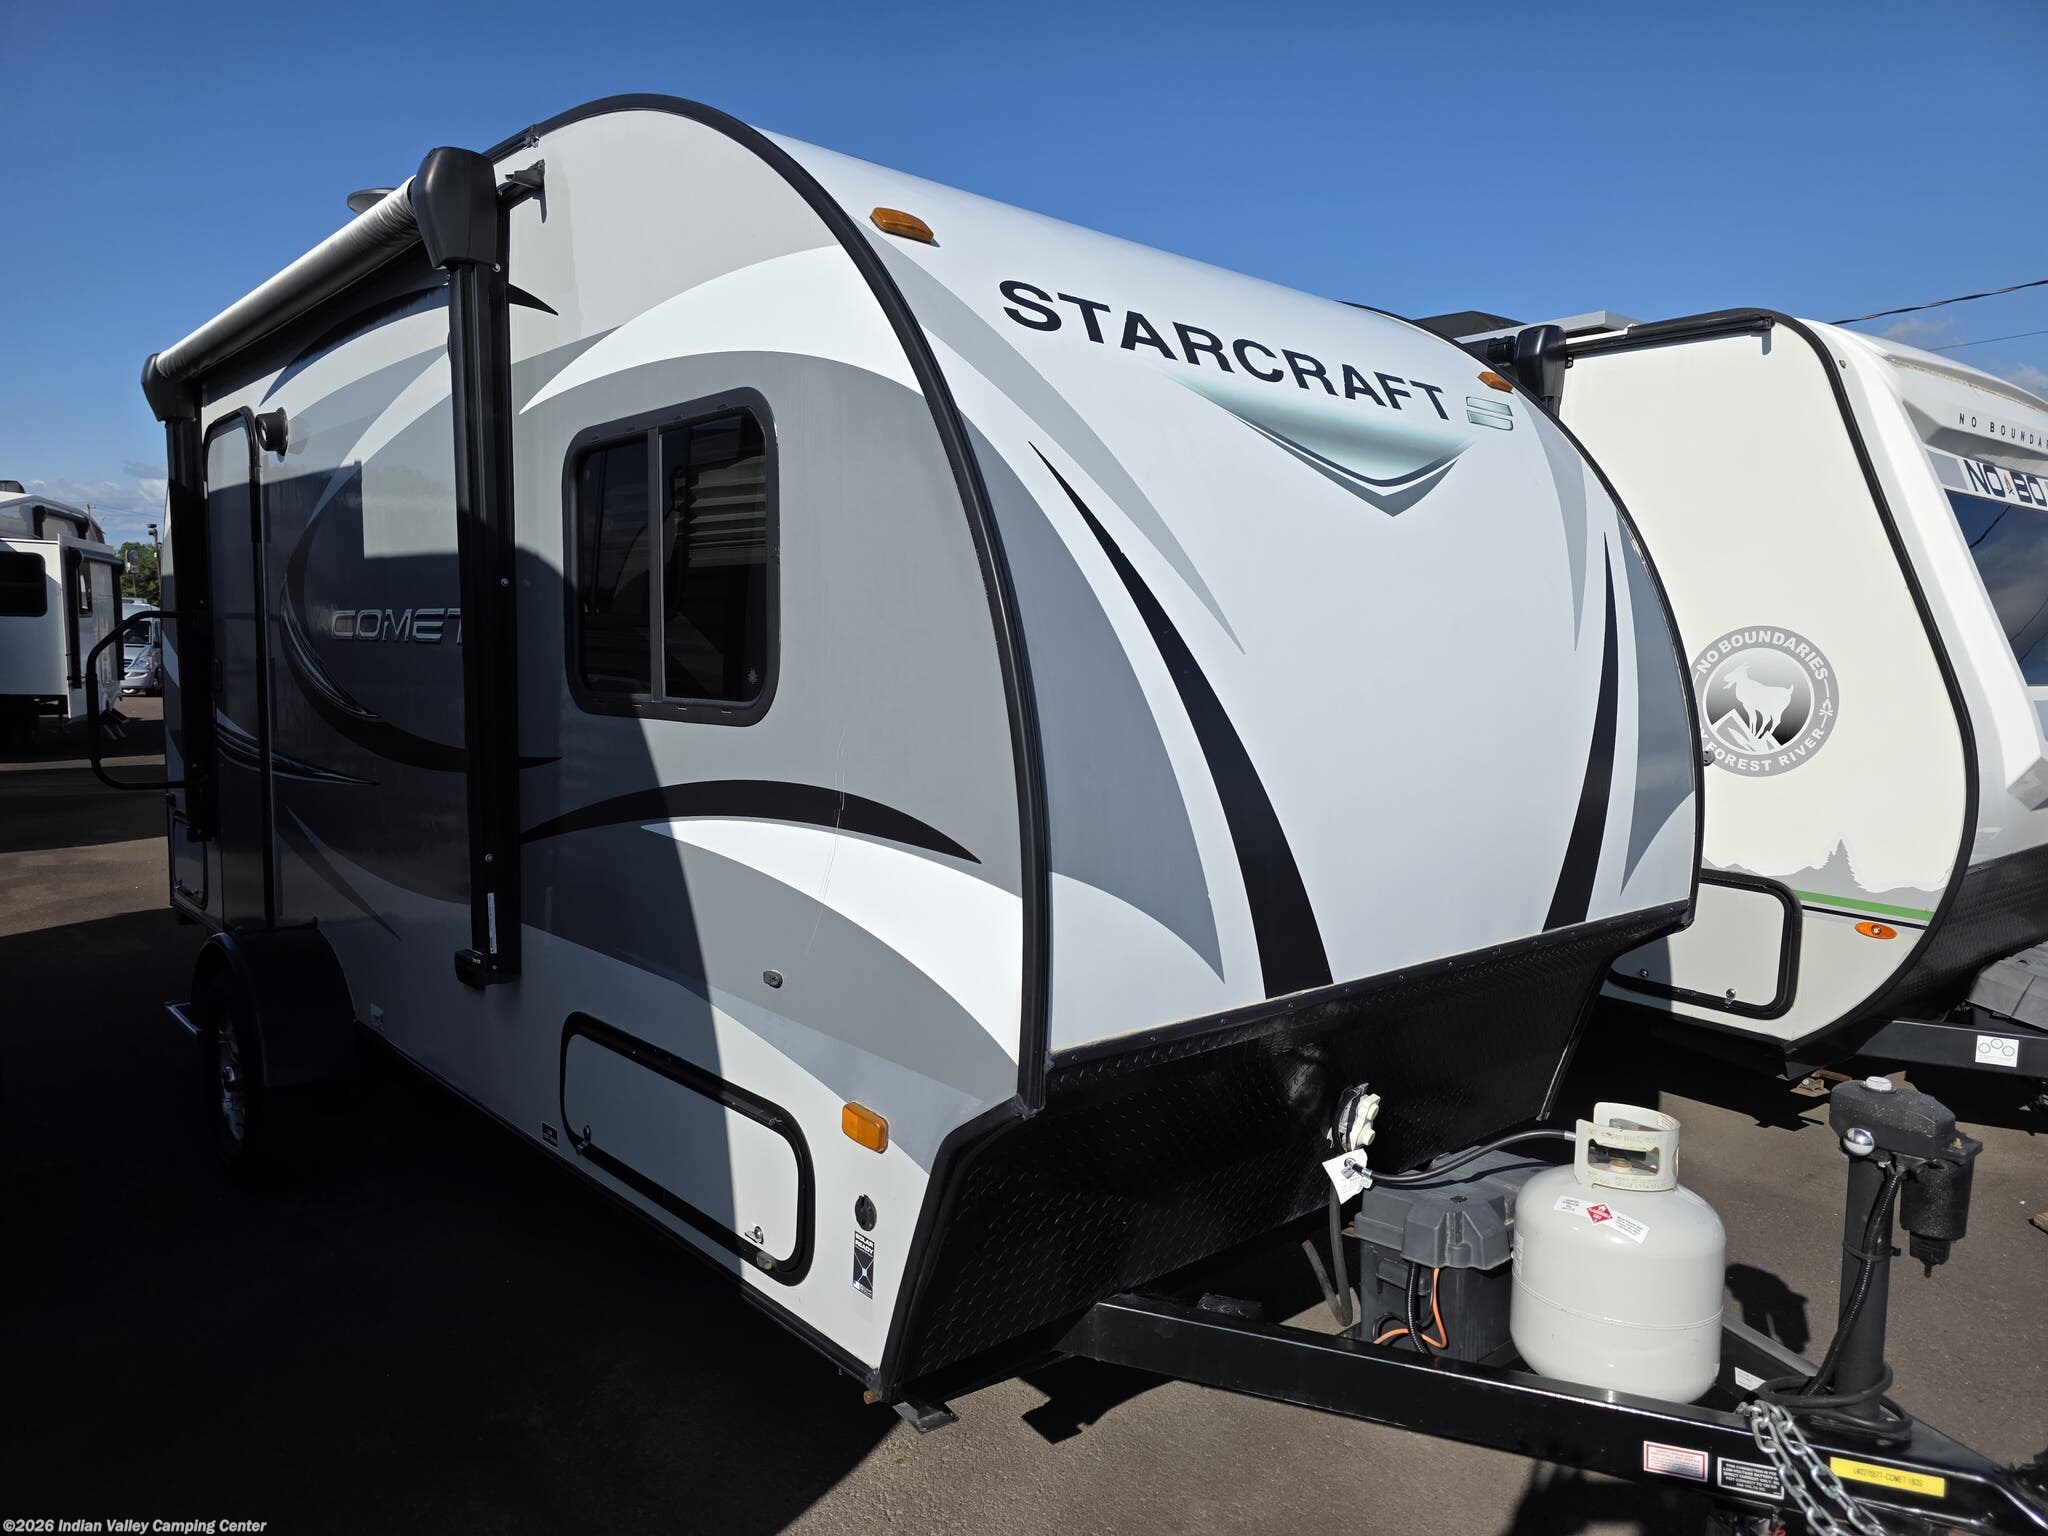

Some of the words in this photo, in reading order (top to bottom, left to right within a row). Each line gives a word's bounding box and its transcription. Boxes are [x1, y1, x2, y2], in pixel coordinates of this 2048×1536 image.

[998, 279, 1450, 421] STARCRAFT
[1959, 412, 1977, 428] NO
[1990, 421, 2048, 450] BOUNDA
[1696, 650, 1720, 674] NO
[1718, 630, 1829, 681] BOUNDARIES
[1704, 741, 1772, 772] FOREST
[1777, 727, 1825, 767] RIVER
